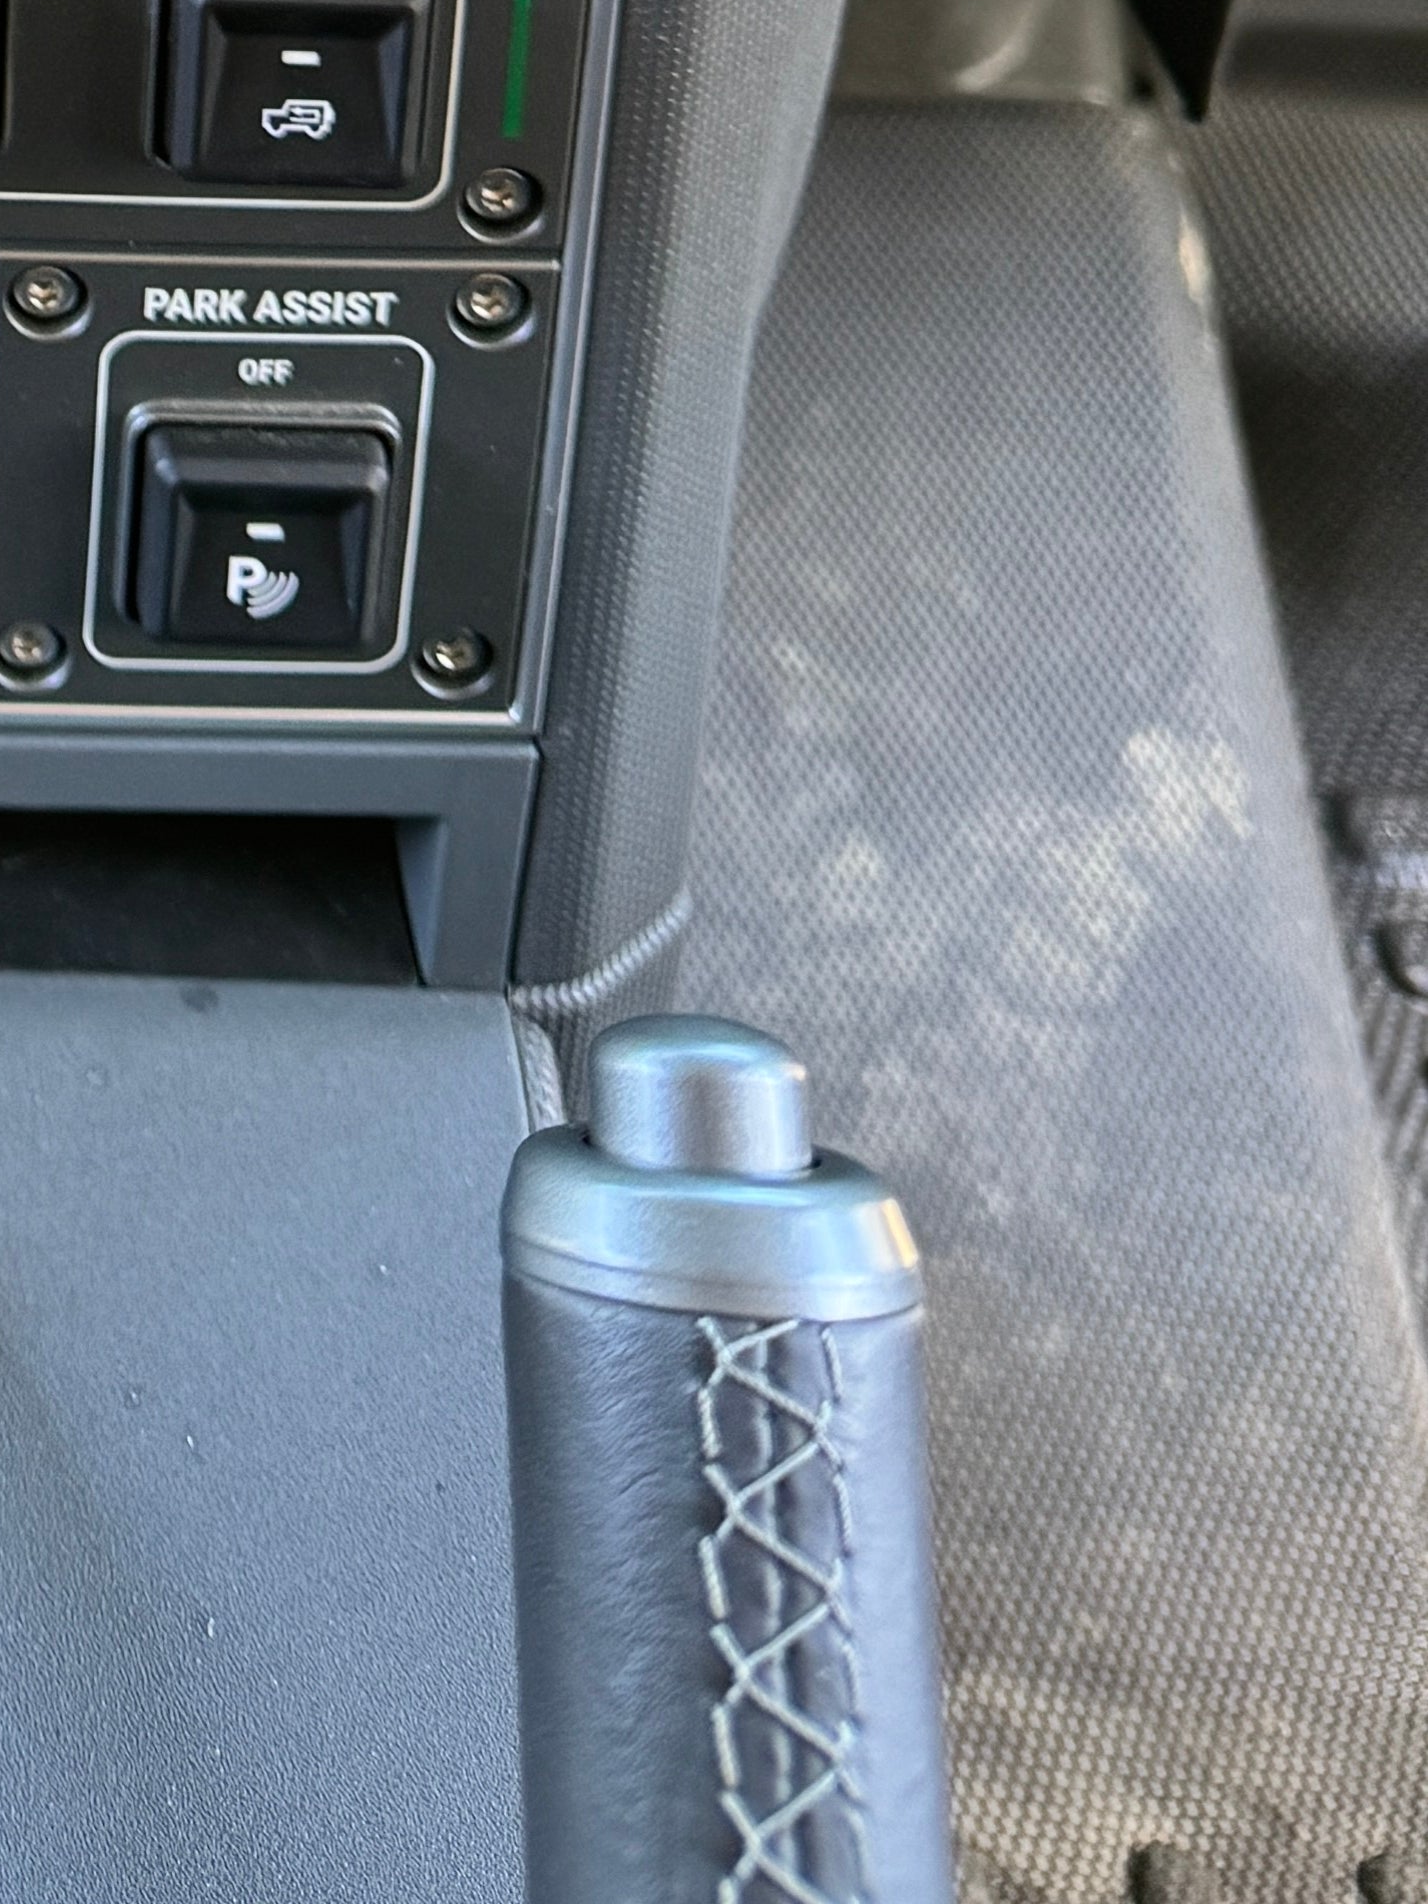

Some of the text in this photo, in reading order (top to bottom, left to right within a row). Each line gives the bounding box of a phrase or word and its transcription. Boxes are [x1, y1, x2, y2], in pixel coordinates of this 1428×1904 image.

[144, 288, 398, 325] PARK ASSIST
[239, 359, 292, 384] OFF
